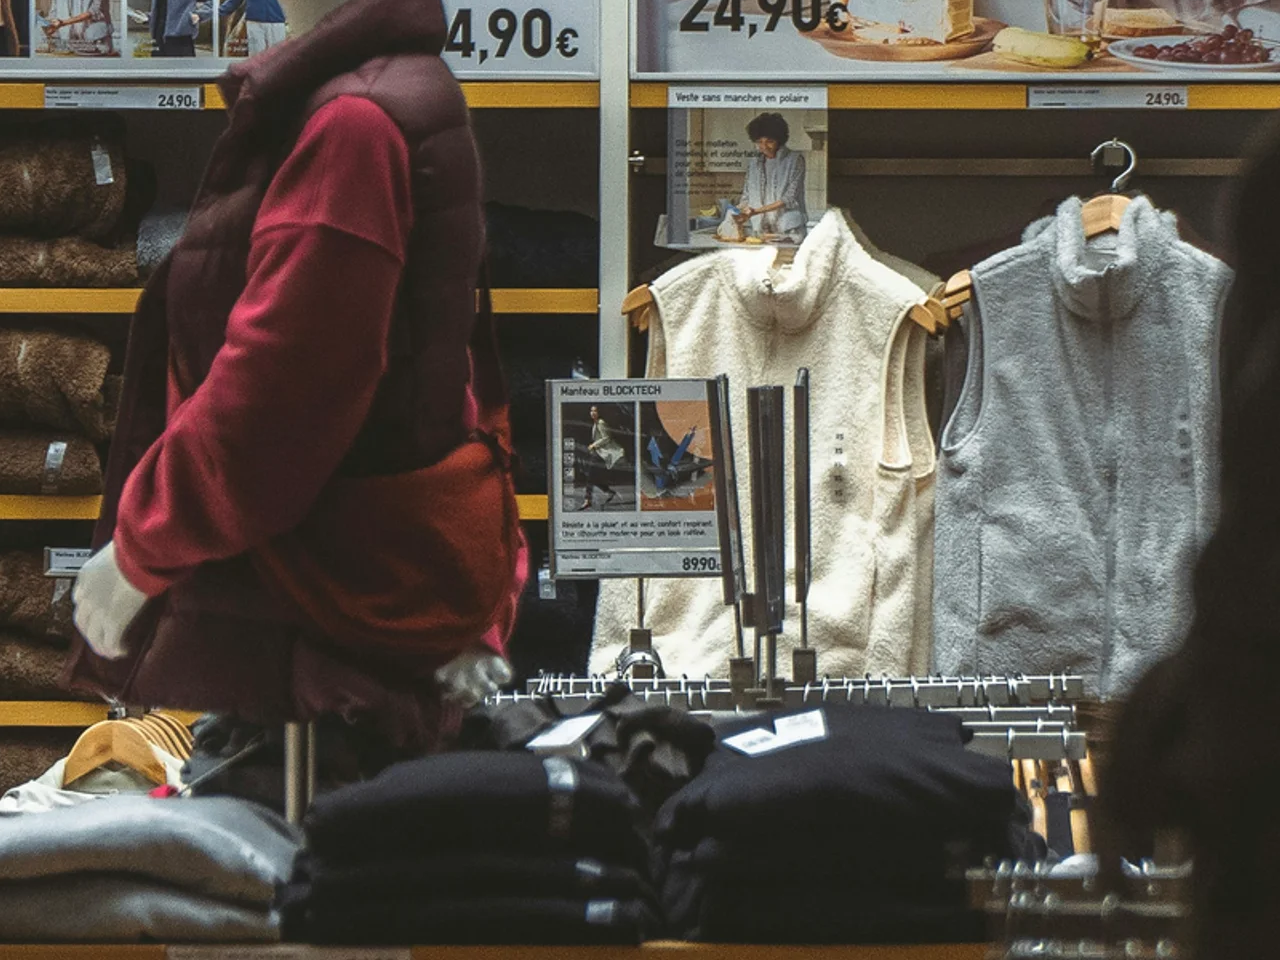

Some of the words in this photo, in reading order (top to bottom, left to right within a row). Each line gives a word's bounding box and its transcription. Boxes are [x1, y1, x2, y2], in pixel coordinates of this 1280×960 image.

[444, 8, 580, 66] 4,90€
[675, 92, 699, 102] Veste
[702, 93, 721, 102] sans
[724, 92, 762, 103] manches
[765, 94, 776, 103] en
[779, 93, 809, 105] polaire
[560, 385, 600, 397] Manteau
[603, 385, 662, 396] BLOCKTECH
